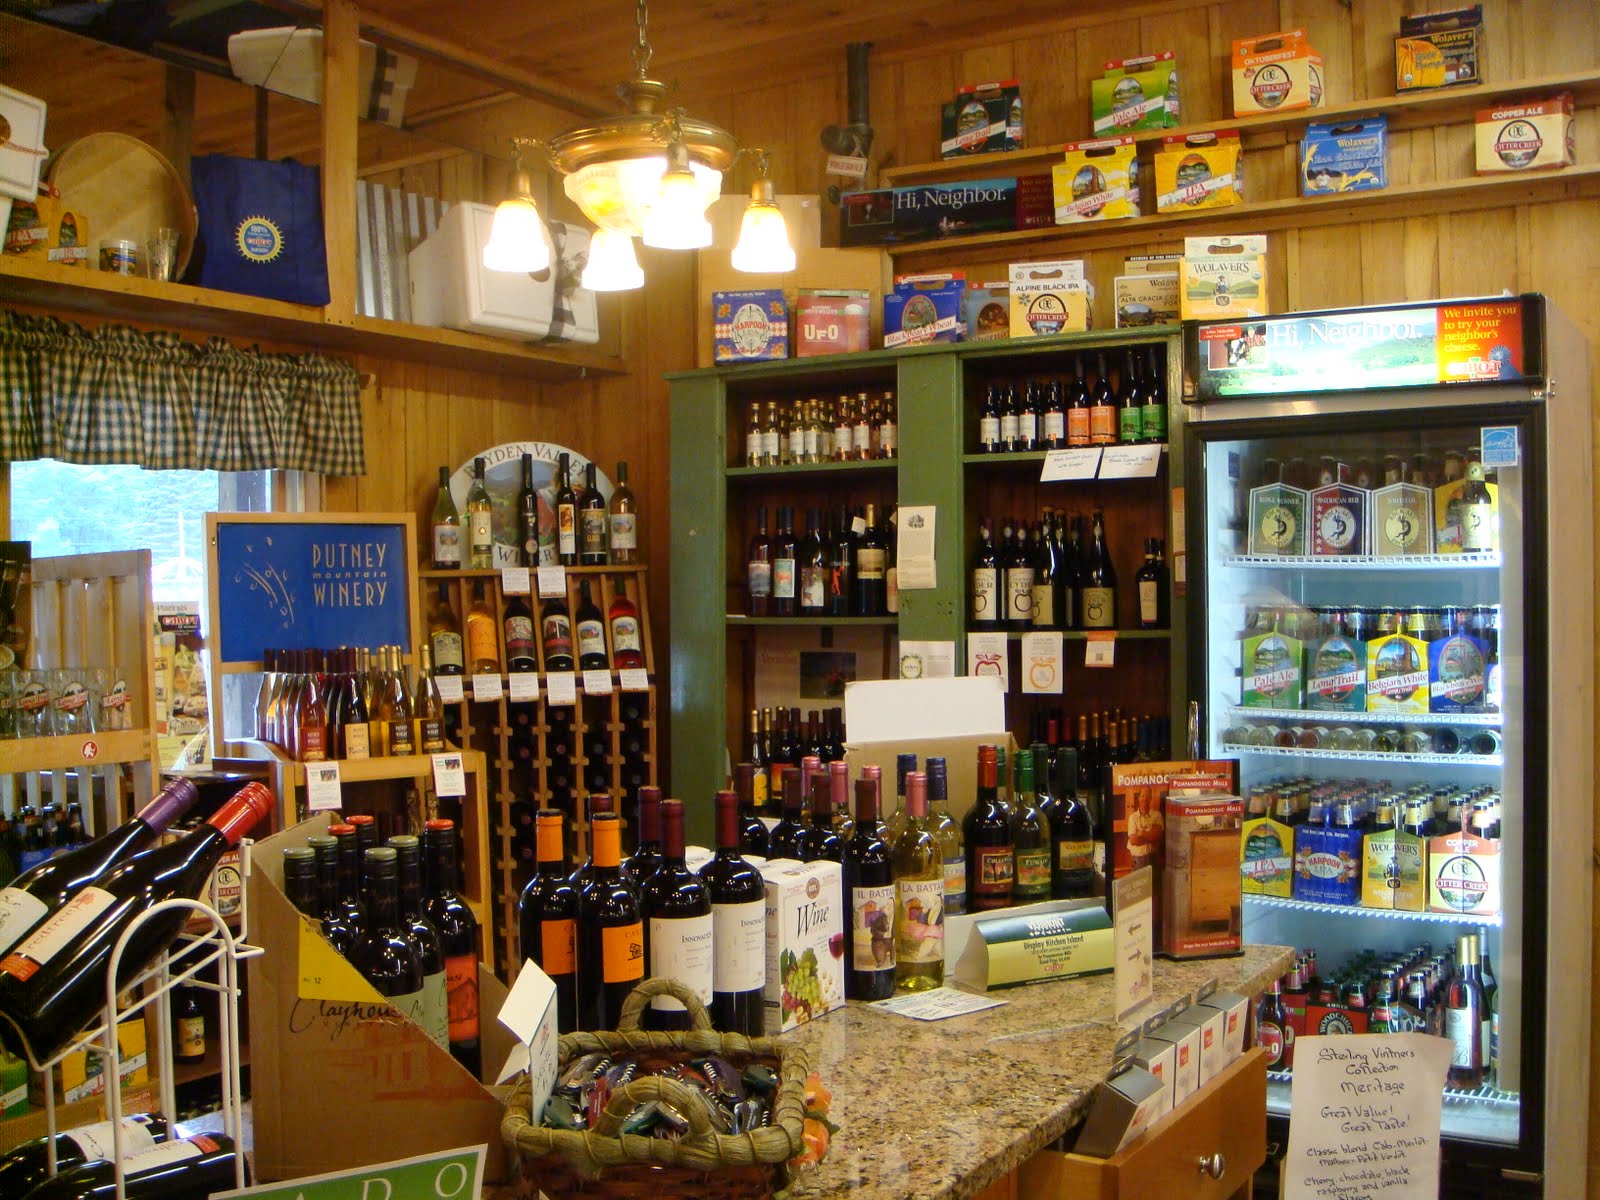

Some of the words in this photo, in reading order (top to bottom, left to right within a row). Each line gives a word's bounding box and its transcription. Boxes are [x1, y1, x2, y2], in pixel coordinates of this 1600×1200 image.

[1244, 50, 1297, 66] OKTOBERFEST
[1251, 84, 1272, 95] OTTER
[1112, 108, 1131, 123] Pale
[1132, 103, 1148, 115] Ale
[1491, 109, 1525, 120] COPPER
[1526, 107, 1544, 116] ALE
[1495, 142, 1518, 152] OTTER
[1518, 141, 1542, 150] CREEK
[1185, 183, 1206, 197] IPA
[896, 192, 921, 211] Hi,
[924, 186, 1007, 209] Neighbor.
[1066, 199, 1092, 213] Belgian
[1092, 190, 1114, 205] White
[1194, 262, 1250, 274] WOLAVER'S
[1016, 284, 1041, 292] ALPINE
[1043, 283, 1067, 291] BLACK
[1068, 282, 1080, 290] IPA
[1027, 313, 1047, 321] OTTER
[1444, 309, 1461, 319] We
[1463, 307, 1494, 318] invite
[1496, 306, 1517, 318] you
[734, 321, 767, 332] HARPOON
[930, 319, 953, 334] Wheat
[1444, 321, 1456, 330] to
[1458, 320, 1473, 331] try
[1476, 319, 1501, 331] your
[804, 324, 839, 341] UFO
[1273, 325, 1304, 350] Hi,
[1307, 318, 1423, 345] Neighbor.
[1444, 329, 1499, 343] neighbor's
[1444, 342, 1481, 353] cheese.
[463, 444, 527, 479] BYDEN
[533, 443, 588, 476] VALEY
[312, 543, 387, 568] PUTNEY
[313, 571, 387, 579] mountain
[313, 581, 388, 607] WINERY
[1254, 675, 1275, 687] Pale
[1278, 669, 1294, 681] Ale
[1334, 672, 1359, 685] Trail
[1368, 678, 1400, 691] Belgian
[1402, 672, 1428, 685] White
[1173, 779, 1212, 788] POMPANOOSUC
[1212, 778, 1228, 787] MILLS
[1185, 806, 1225, 815] POMPANOOSUC
[1226, 805, 1242, 813] MILLS
[1445, 839, 1479, 847] COPPER
[1253, 858, 1276, 872] IPA
[1308, 857, 1341, 869] HARPOON
[902, 883, 913, 893] LA
[1436, 879, 1463, 889] OTTER
[1463, 880, 1488, 891] CREEK
[857, 889, 866, 899] IL
[797, 901, 830, 939] Wine
[1026, 917, 1065, 931] VERMONT
[1023, 939, 1045, 952] Display
[1045, 937, 1067, 947] Kitchen
[1066, 934, 1084, 944] Island
[314, 977, 321, 985] 12
[1317, 1048, 1369, 1065] Sterling
[1371, 1047, 1415, 1060] Vintners
[1345, 1062, 1399, 1076] Collection
[1340, 1077, 1405, 1096] Meritage
[1320, 1105, 1353, 1119] Great
[1353, 1104, 1394, 1119] Value!
[1340, 1120, 1372, 1134] Great
[1306, 1147, 1338, 1157] Classic
[1340, 1141, 1368, 1154] blend
[1361, 1180, 1379, 1191] and
